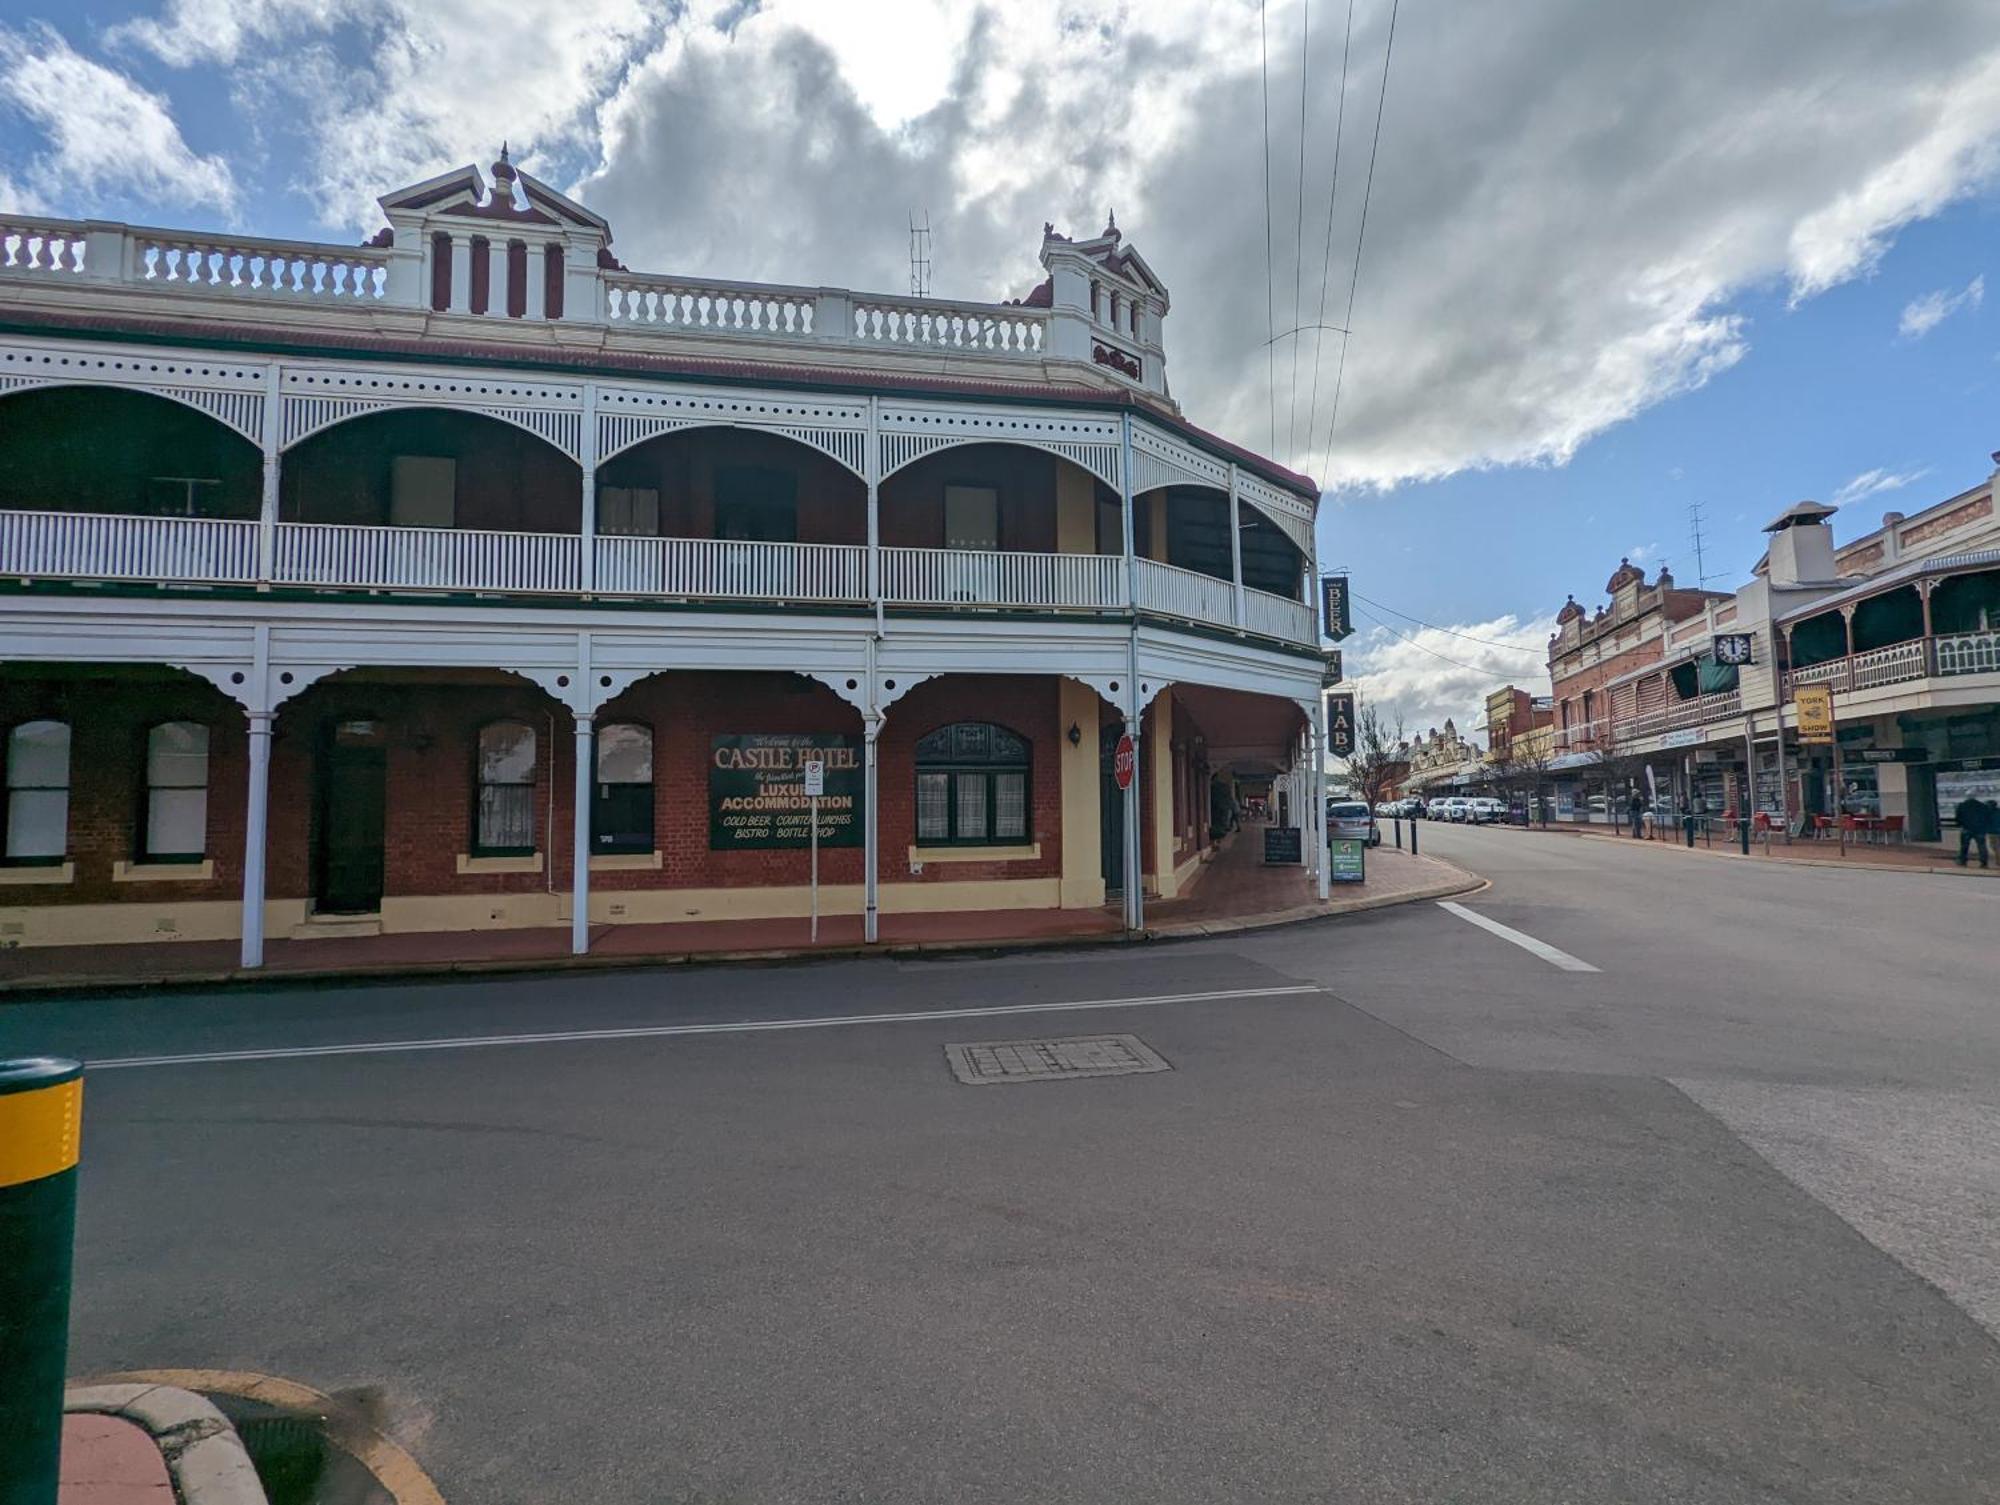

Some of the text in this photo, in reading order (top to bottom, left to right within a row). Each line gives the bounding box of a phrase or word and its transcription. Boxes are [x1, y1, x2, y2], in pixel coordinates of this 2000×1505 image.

[1328, 588, 1344, 635] BEER
[1800, 696, 1825, 704] YORK
[1332, 698, 1349, 745] TAB
[1801, 724, 1828, 732] SHOW
[715, 747, 860, 769] CASTLE HOTEL
[1116, 751, 1133, 774] STOP
[721, 796, 853, 810] ACCOMMODATION
[723, 815, 747, 826] COLD
[748, 815, 771, 826] BEER
[734, 828, 769, 839] BISTRO
[776, 827, 808, 838] BOTTLE
